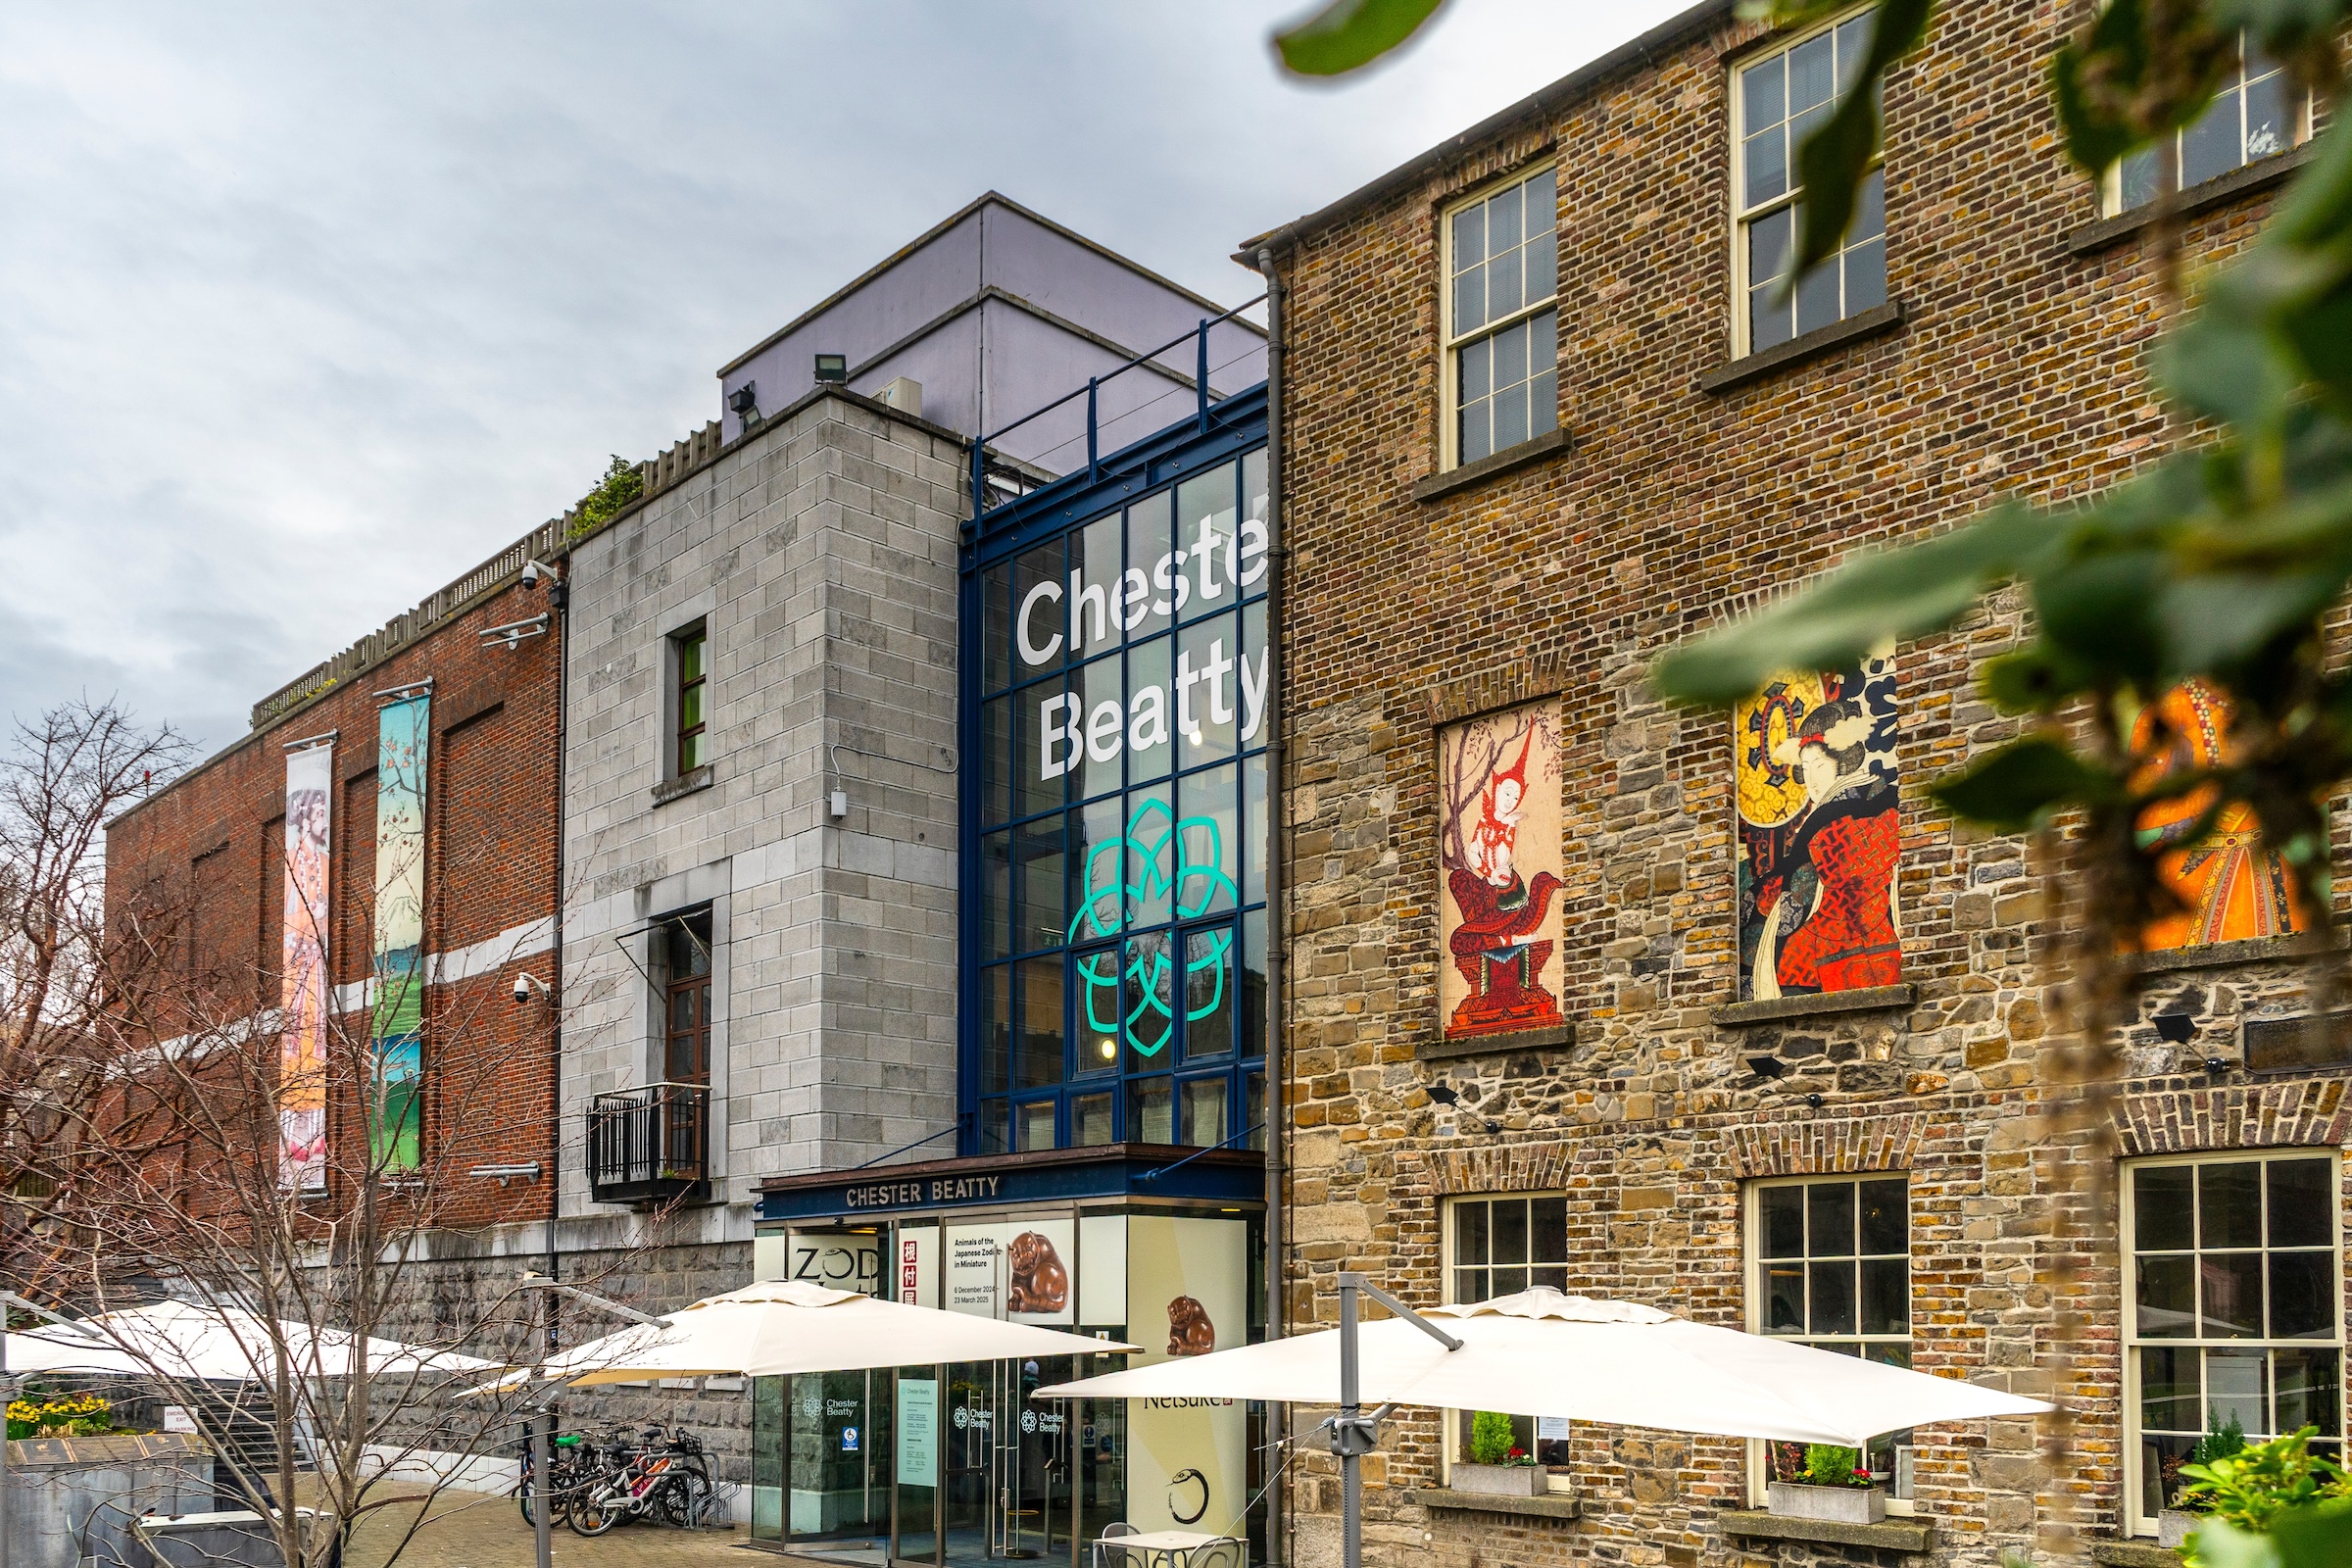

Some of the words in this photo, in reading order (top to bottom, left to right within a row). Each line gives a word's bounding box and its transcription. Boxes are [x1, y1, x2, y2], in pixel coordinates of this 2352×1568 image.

[1016, 513, 1269, 666] Cheste
[1040, 637, 1269, 781] Beatty
[846, 1183, 922, 1207] CHESTER
[932, 1176, 999, 1200] BEATTY
[955, 1238, 977, 1247] Animals
[955, 1250, 981, 1258] Japanese
[826, 1398, 858, 1407] Chester
[826, 1407, 854, 1417] Beatty
[970, 1408, 993, 1419] Chester
[1039, 1412, 1064, 1423] Chester
[970, 1418, 990, 1430] Beatty
[1039, 1422, 1060, 1435] Beatty
